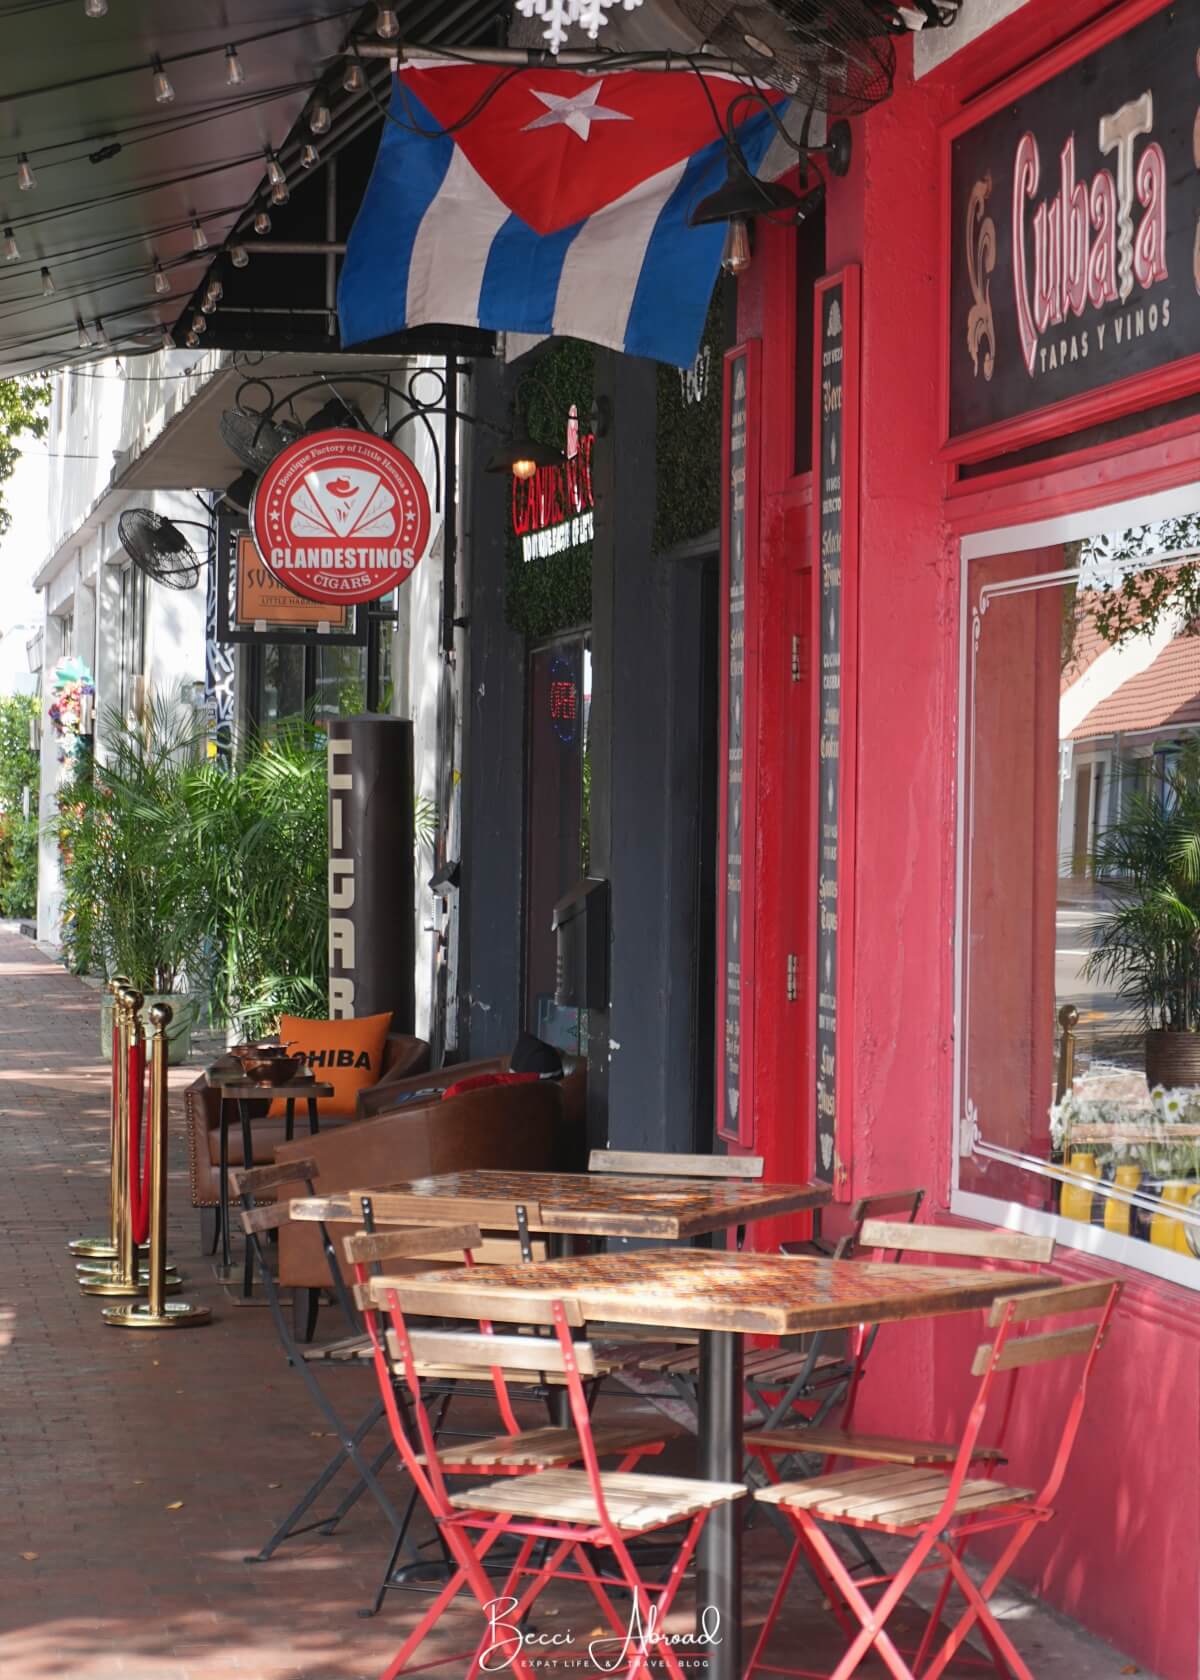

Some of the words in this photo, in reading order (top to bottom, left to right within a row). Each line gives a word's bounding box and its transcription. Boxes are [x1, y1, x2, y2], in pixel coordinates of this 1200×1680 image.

[1040, 331, 1089, 374] TAPAS
[1097, 323, 1105, 351] Y
[1114, 298, 1170, 345] VINOS
[279, 454, 310, 488] Boutique
[310, 445, 344, 458] Factory
[346, 444, 357, 452] of
[358, 446, 382, 462] Little
[381, 457, 405, 489] Havana
[270, 547, 415, 569] CLANDESTINOS
[313, 573, 371, 590] CIGARS
[550, 681, 576, 720] OPEN
[292, 1049, 371, 1071] OHIBA
